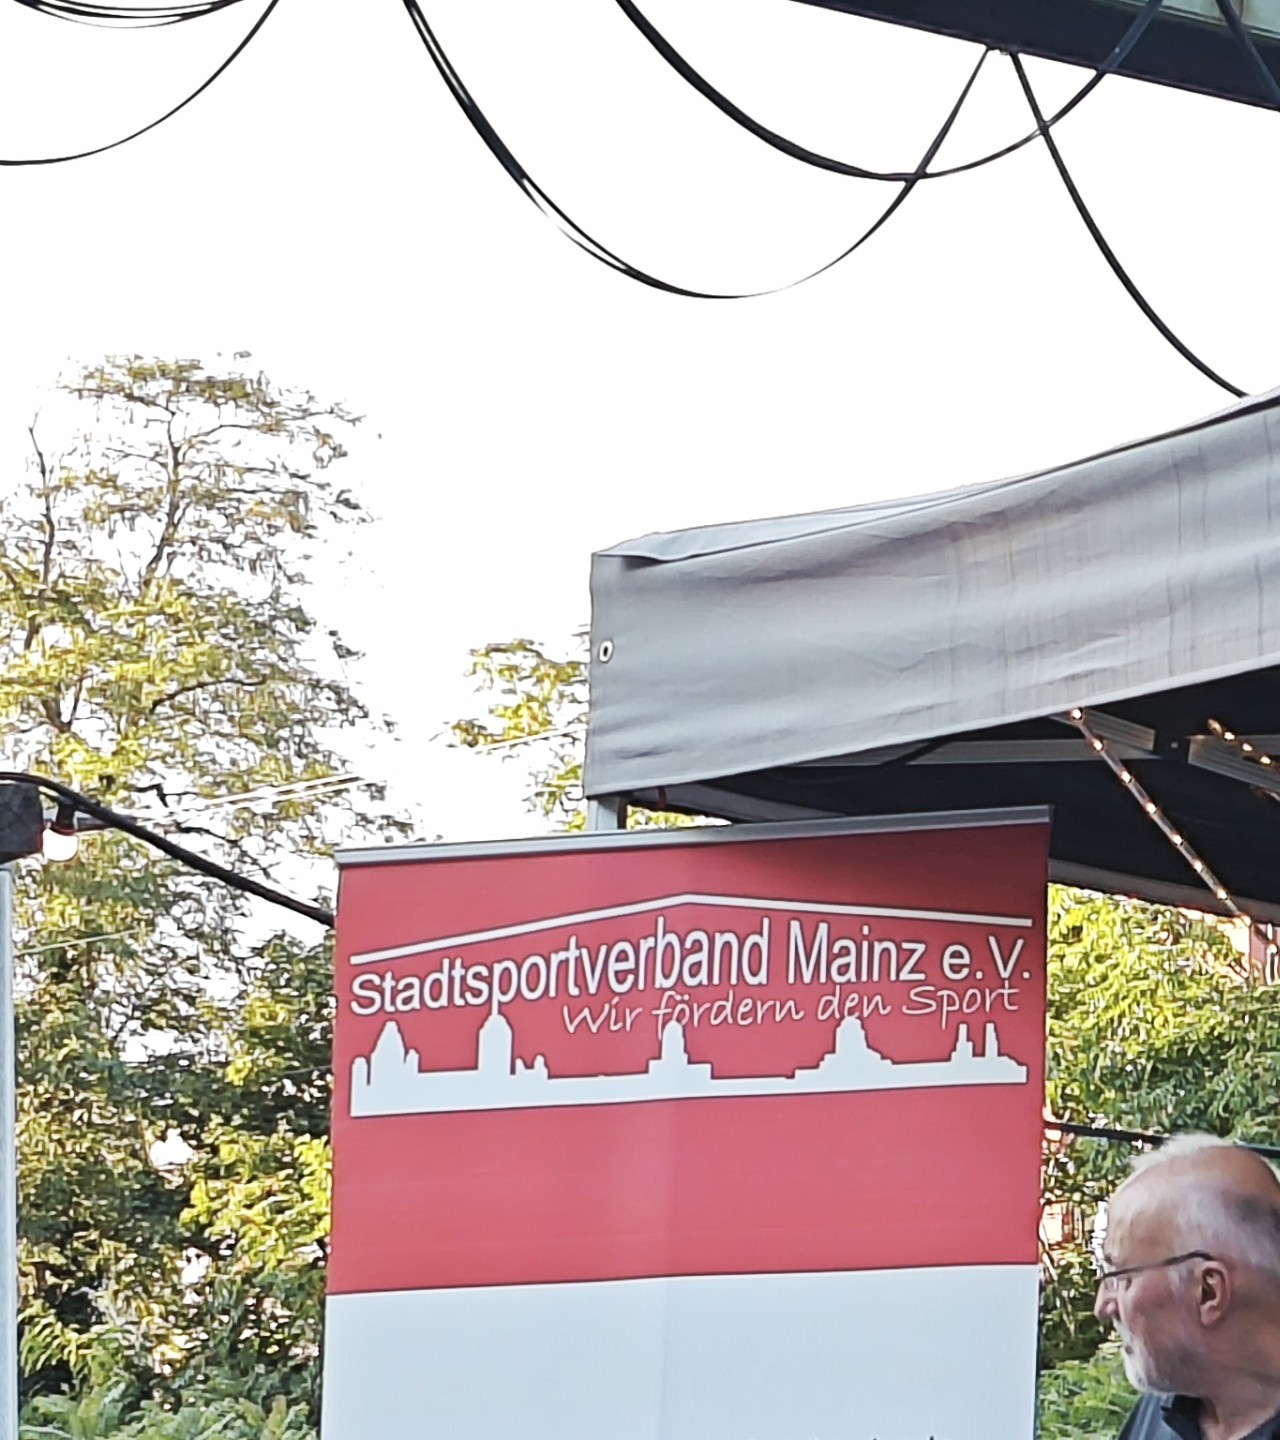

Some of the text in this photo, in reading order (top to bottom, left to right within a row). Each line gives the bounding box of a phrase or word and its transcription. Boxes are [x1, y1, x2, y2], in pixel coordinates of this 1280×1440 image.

[350, 917, 770, 1017] Stadtsportverband
[788, 919, 926, 984] Mainz
[563, 982, 1020, 1041] Wir fördern den Sport
